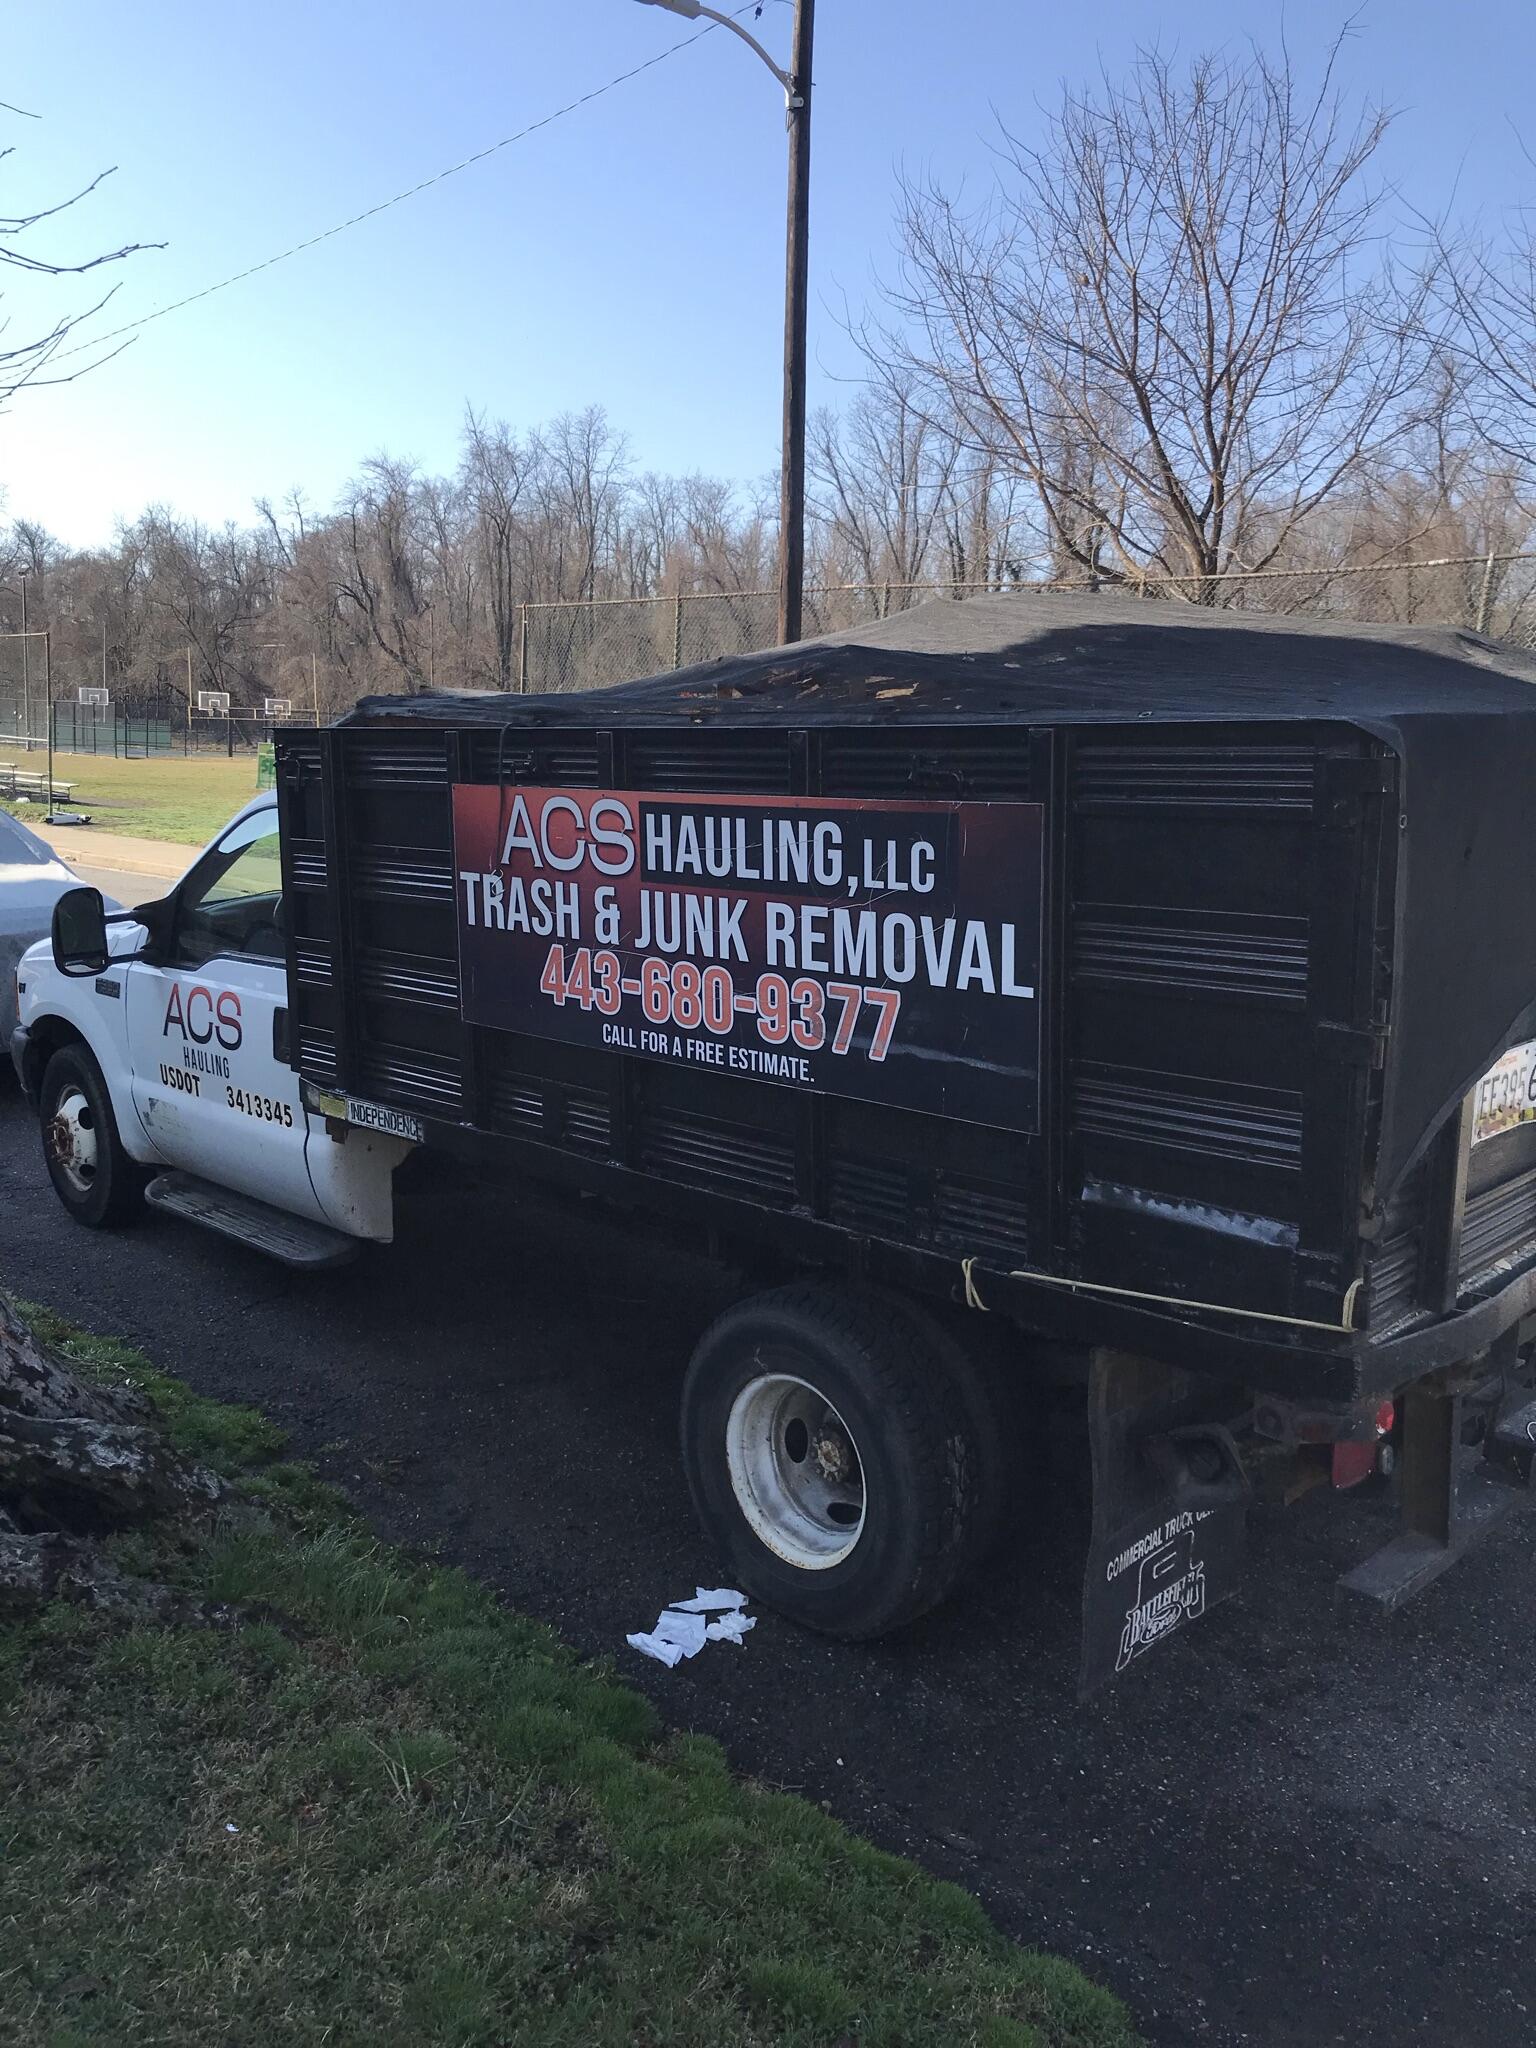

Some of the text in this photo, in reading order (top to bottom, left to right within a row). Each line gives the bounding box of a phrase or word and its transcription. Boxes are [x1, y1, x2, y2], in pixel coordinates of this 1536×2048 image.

[500, 794, 636, 876] ACS
[460, 871, 1034, 998] TRASH & JUNK REMOVAL
[163, 983, 242, 1051] ACS
[539, 943, 901, 1062] 443-680-9377
[183, 1046, 230, 1079] HAULING
[602, 1023, 815, 1082] CALL FOR A FREE ESTIMATE.
[160, 1063, 293, 1128] USDOT 3413345
[350, 1102, 424, 1141] INDEPENDENCE
[1106, 1511, 1194, 1582] COMMERCIAL TRUCK
